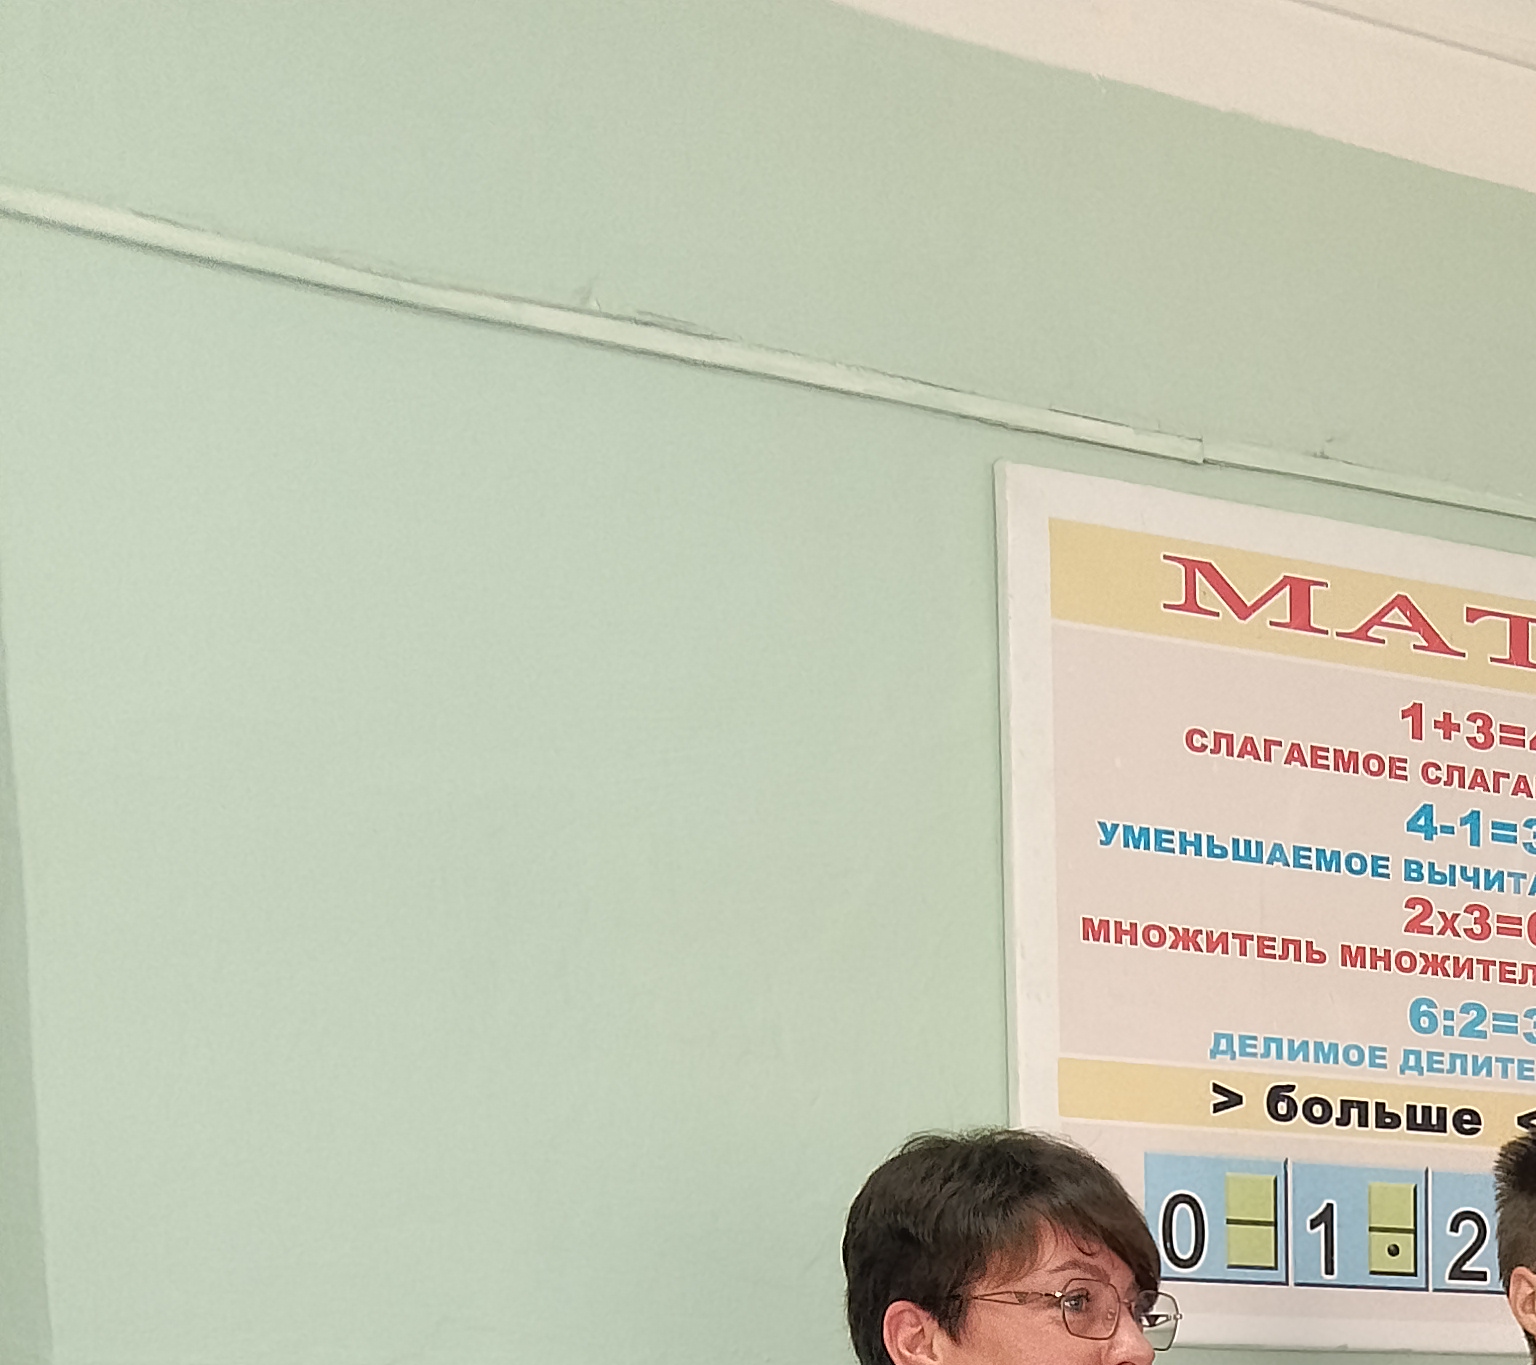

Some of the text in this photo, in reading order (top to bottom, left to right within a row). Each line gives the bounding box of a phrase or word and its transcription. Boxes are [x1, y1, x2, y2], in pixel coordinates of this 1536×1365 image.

[1183, 727, 1410, 783] СЛАГАЕМОЕ
[1096, 820, 1393, 881] УМЕНЬШАЕМОЕ
[1080, 916, 1328, 966] МНОЖИТЕЛЬ
[1208, 1030, 1389, 1071] ДЕЛИМОЕ
[1266, 1082, 1484, 1136] больше
[1161, 1192, 1208, 1271] 0
[1307, 1201, 1337, 1277] 1
[1446, 1209, 1490, 1282] 2
